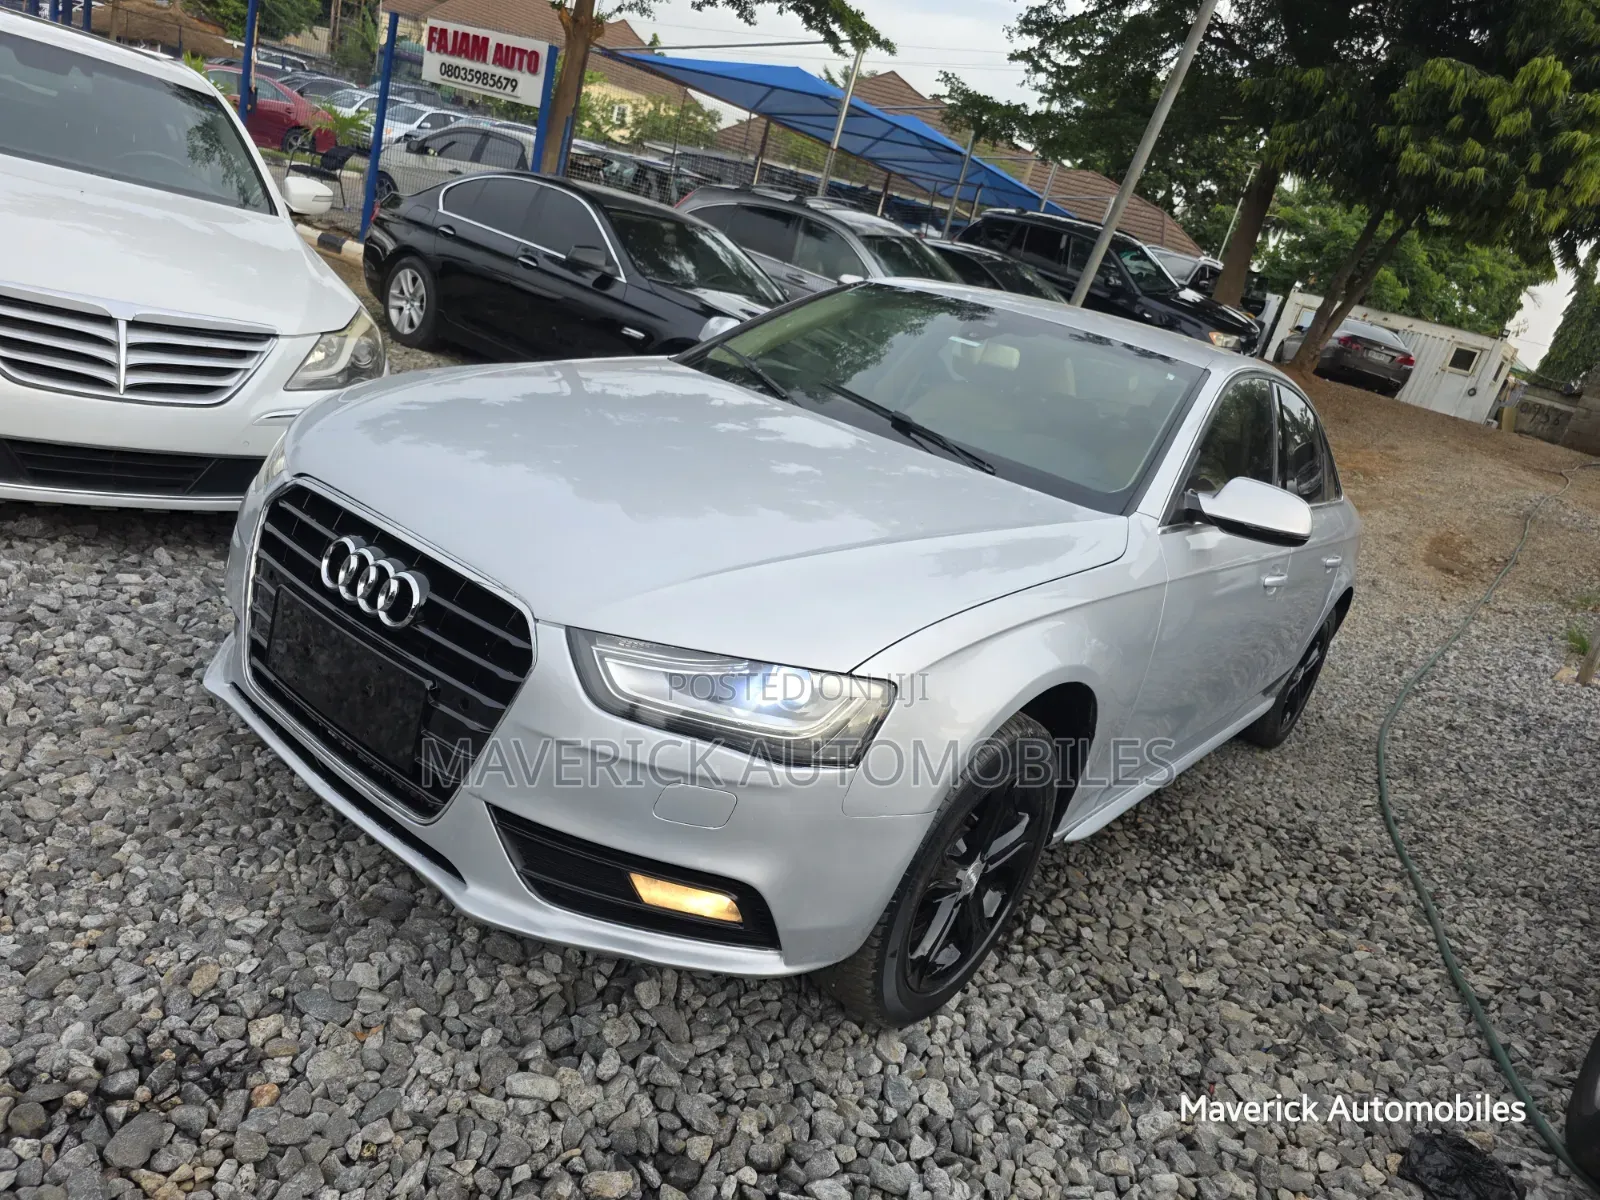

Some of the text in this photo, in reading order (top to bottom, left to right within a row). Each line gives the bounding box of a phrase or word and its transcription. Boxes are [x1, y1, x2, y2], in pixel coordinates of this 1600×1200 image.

[427, 26, 540, 75] FAJAM AUTO
[439, 62, 518, 92] 08035985679
